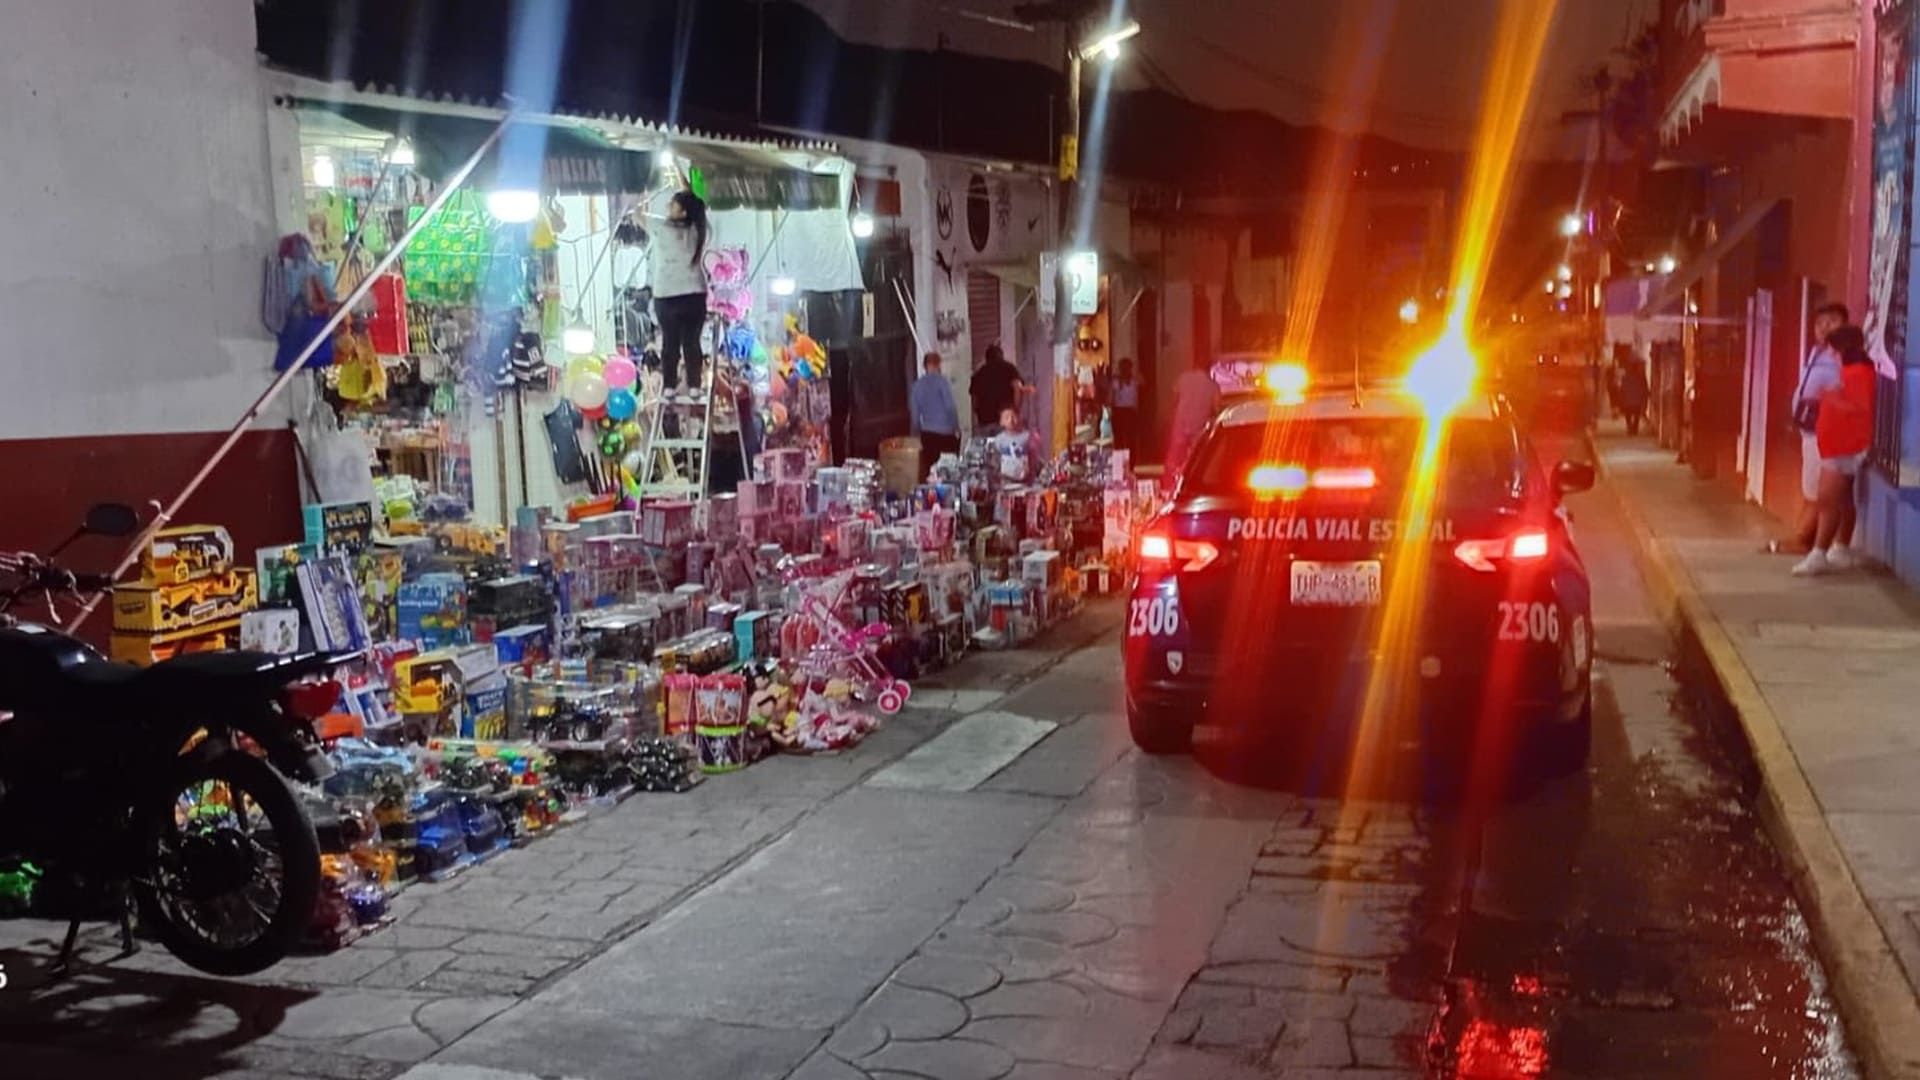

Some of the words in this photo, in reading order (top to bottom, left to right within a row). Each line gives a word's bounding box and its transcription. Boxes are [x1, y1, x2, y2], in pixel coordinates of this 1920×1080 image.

[1315, 518, 1362, 540] VIAL
[1130, 598, 1178, 636] 2306
[1498, 601, 1559, 643] 2306
